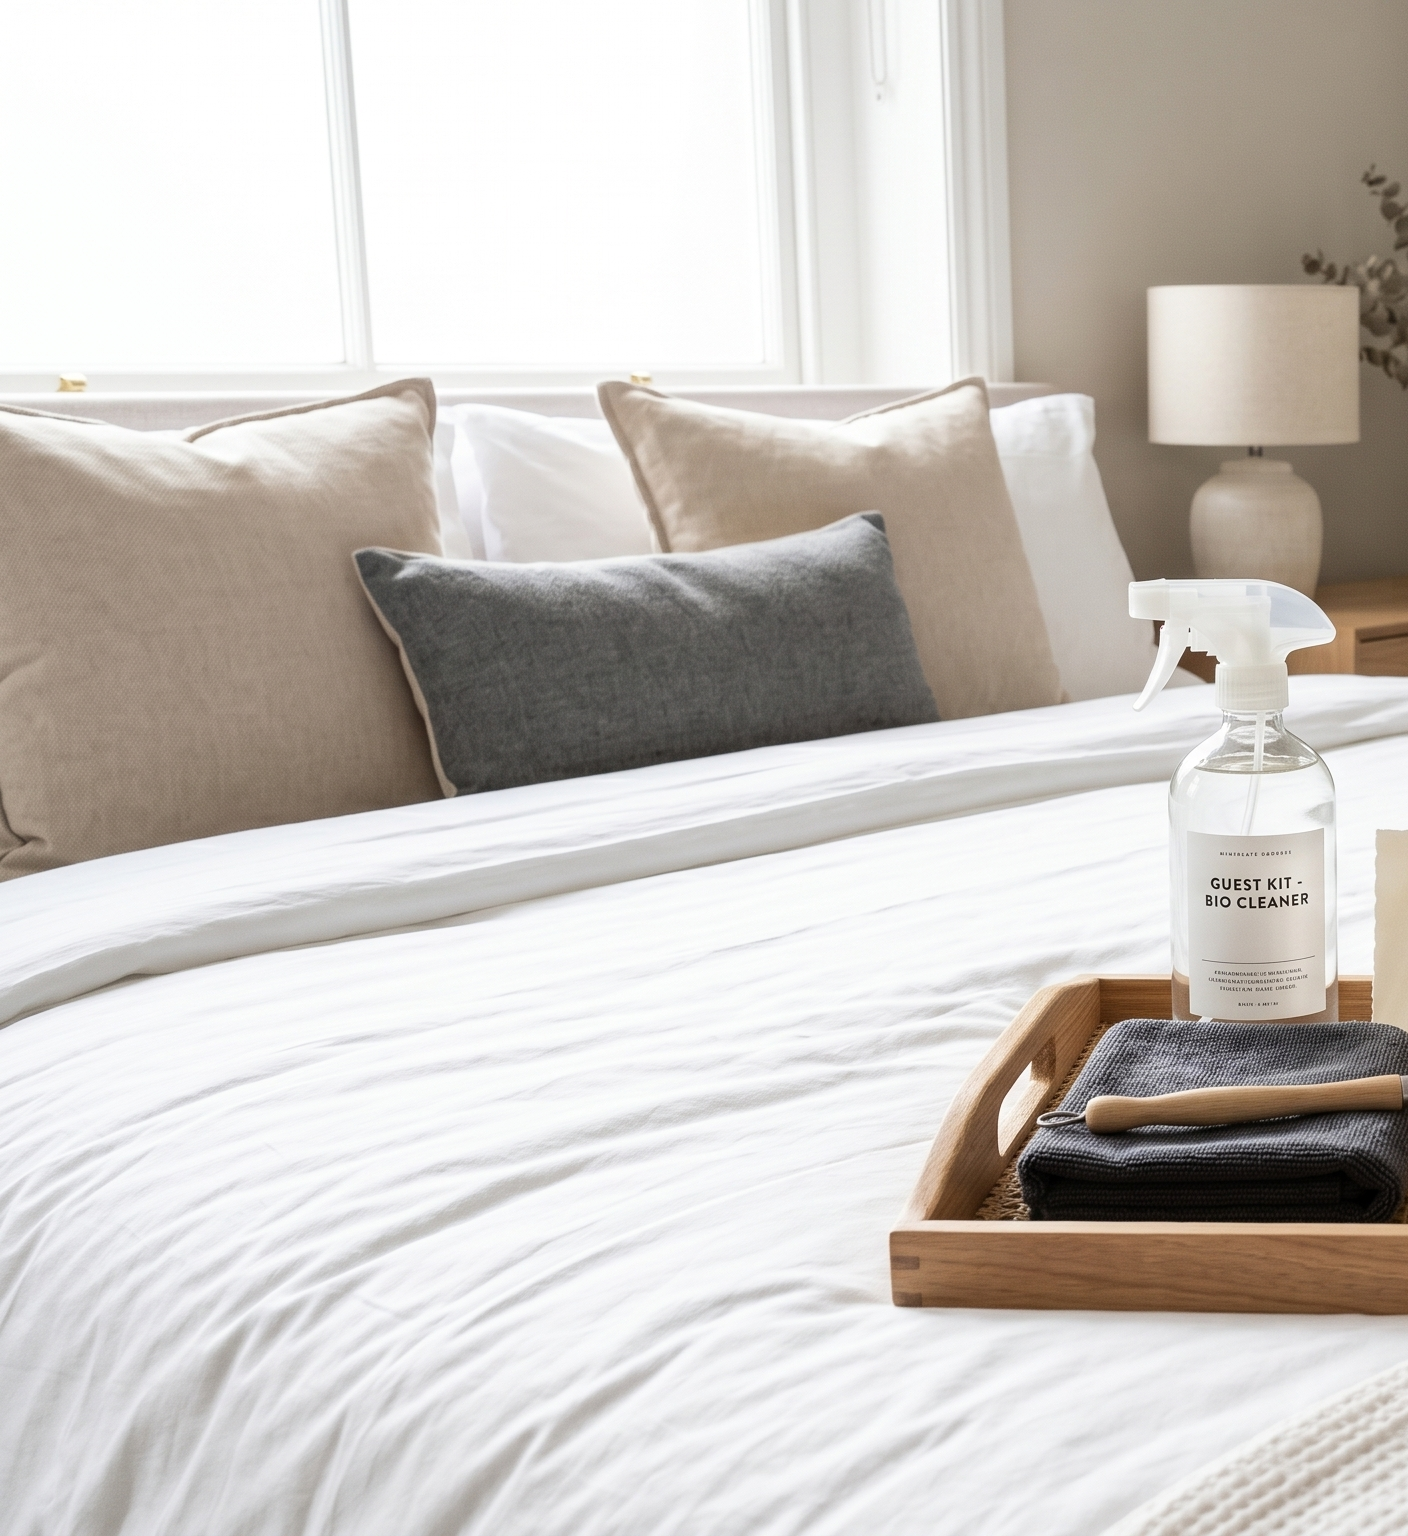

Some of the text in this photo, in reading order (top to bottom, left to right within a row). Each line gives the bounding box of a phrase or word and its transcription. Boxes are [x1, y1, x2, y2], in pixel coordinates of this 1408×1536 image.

[1210, 877, 1261, 891] GUEST
[1268, 877, 1292, 890] KIT
[1206, 893, 1309, 909] BIO CLEANER
